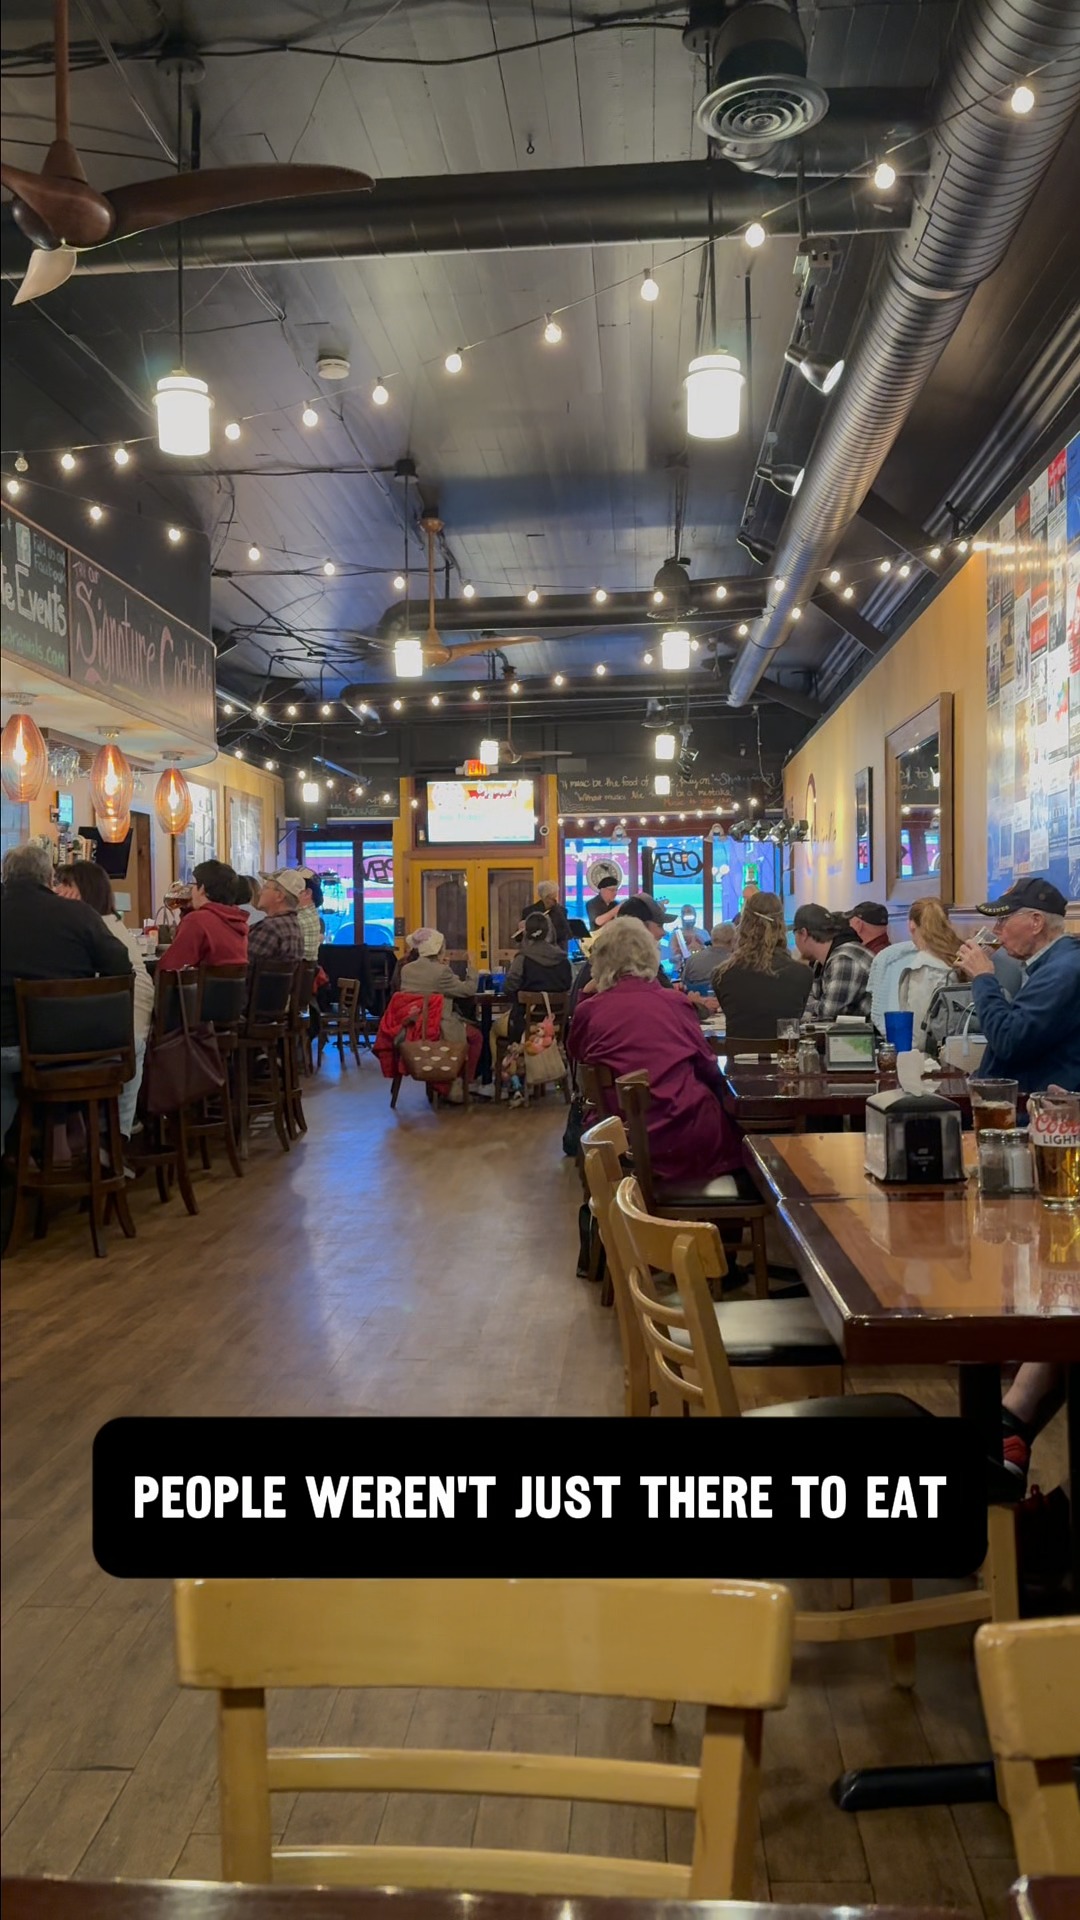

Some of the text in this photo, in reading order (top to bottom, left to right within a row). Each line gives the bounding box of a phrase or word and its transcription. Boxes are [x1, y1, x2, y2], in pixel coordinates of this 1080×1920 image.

[76, 581, 155, 691] Signature
[622, 775, 638, 787] food
[979, 904, 1010, 914] MARINES
[1035, 1113, 1080, 1134] Coor
[1042, 1134, 1080, 1145] LIGHT
